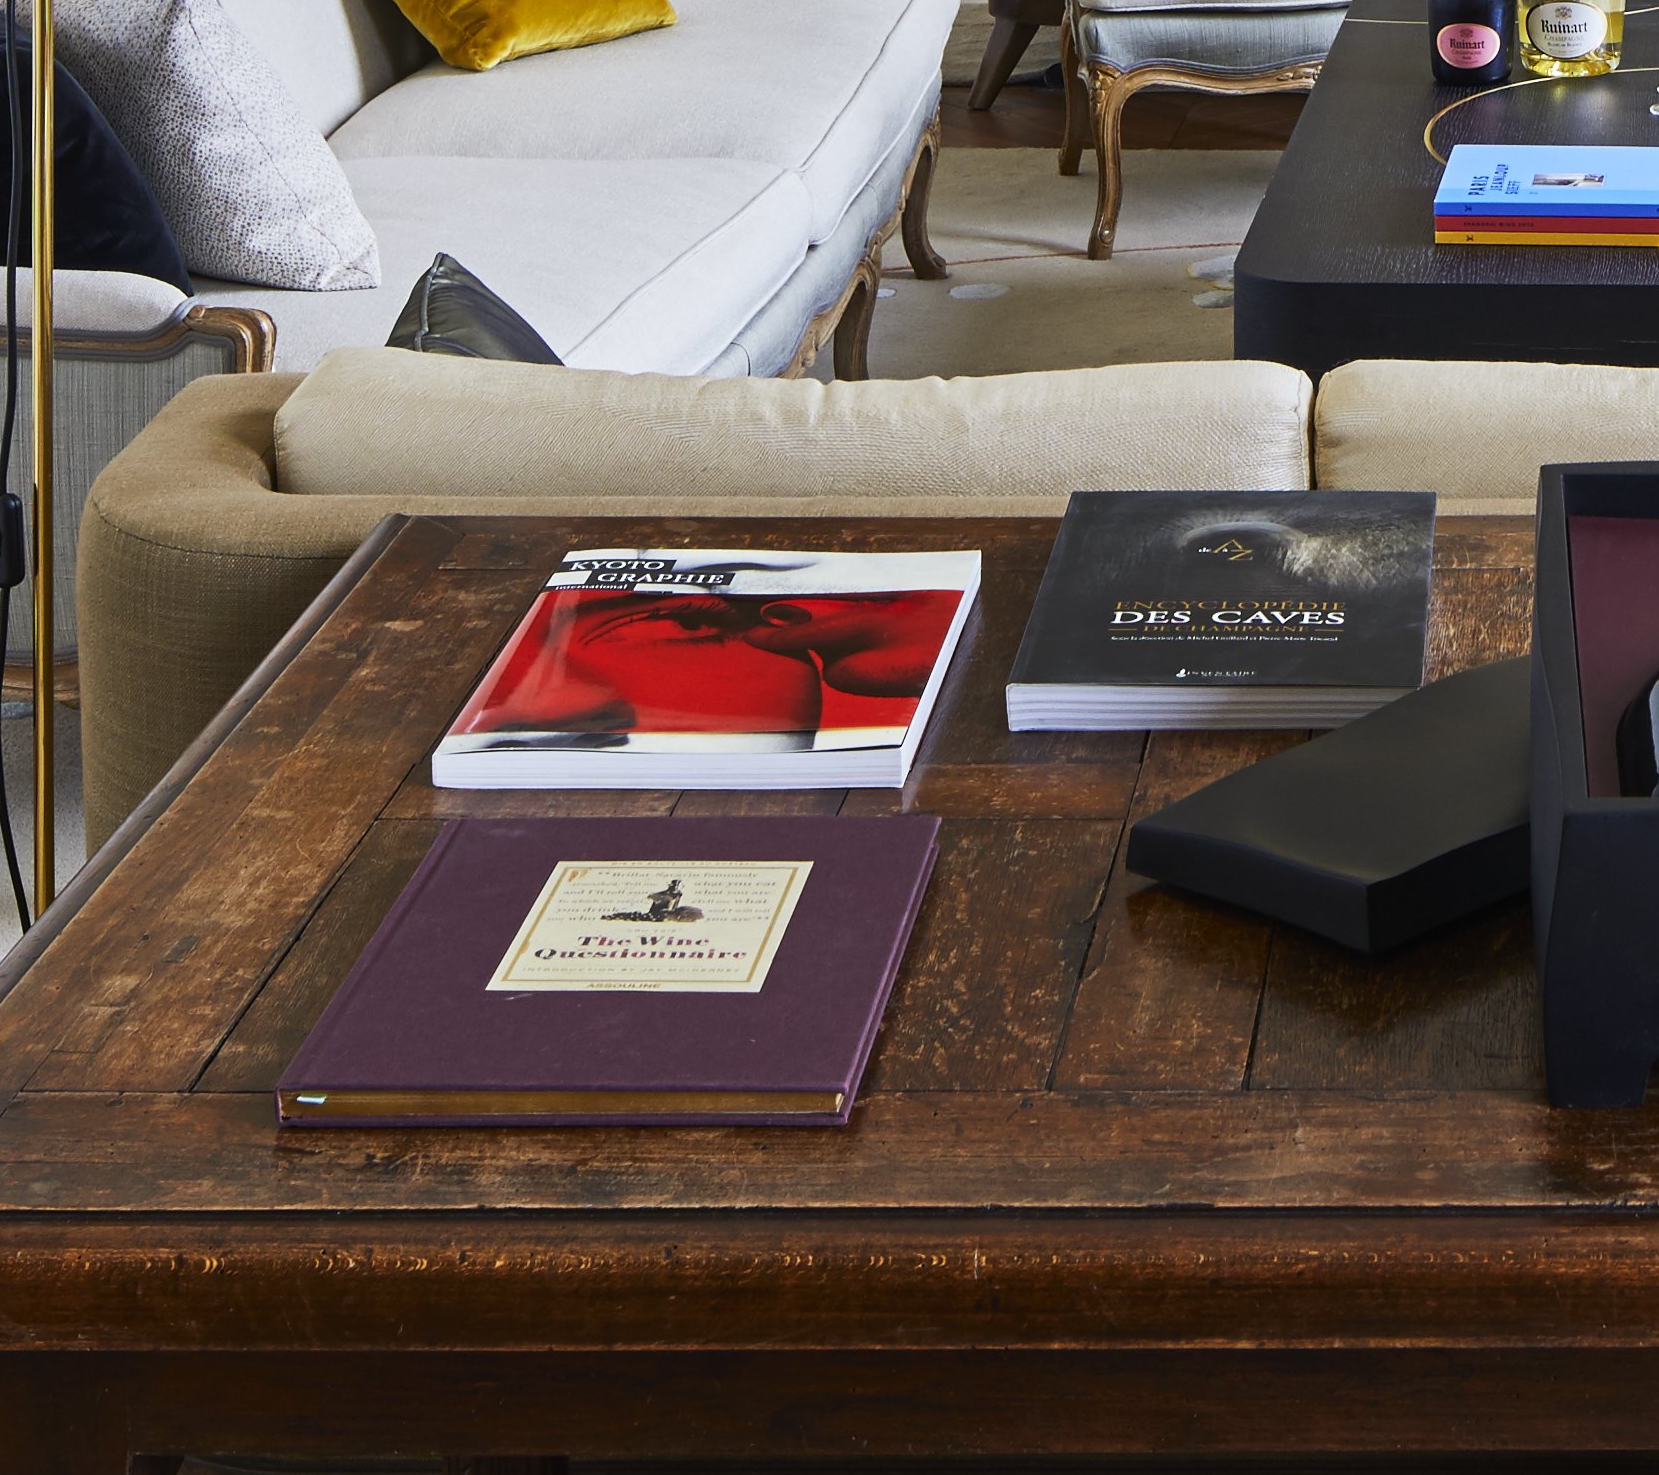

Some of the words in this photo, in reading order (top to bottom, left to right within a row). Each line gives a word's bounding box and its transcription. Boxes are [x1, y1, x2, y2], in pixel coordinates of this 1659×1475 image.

[1541, 20, 1588, 34] Ruinart
[1449, 38, 1485, 49] Ruinart
[1468, 176, 1490, 196] PARIS
[569, 560, 666, 571] KYOTO
[597, 572, 725, 584] GRAPHIE
[555, 583, 628, 591] international
[1114, 598, 1346, 611] ENCYCLOPÉDIE
[1110, 610, 1191, 625] DES
[1211, 610, 1345, 625] CAVES
[577, 935, 631, 947] The
[638, 935, 710, 947] Wine
[532, 948, 748, 961] Questionnaire
